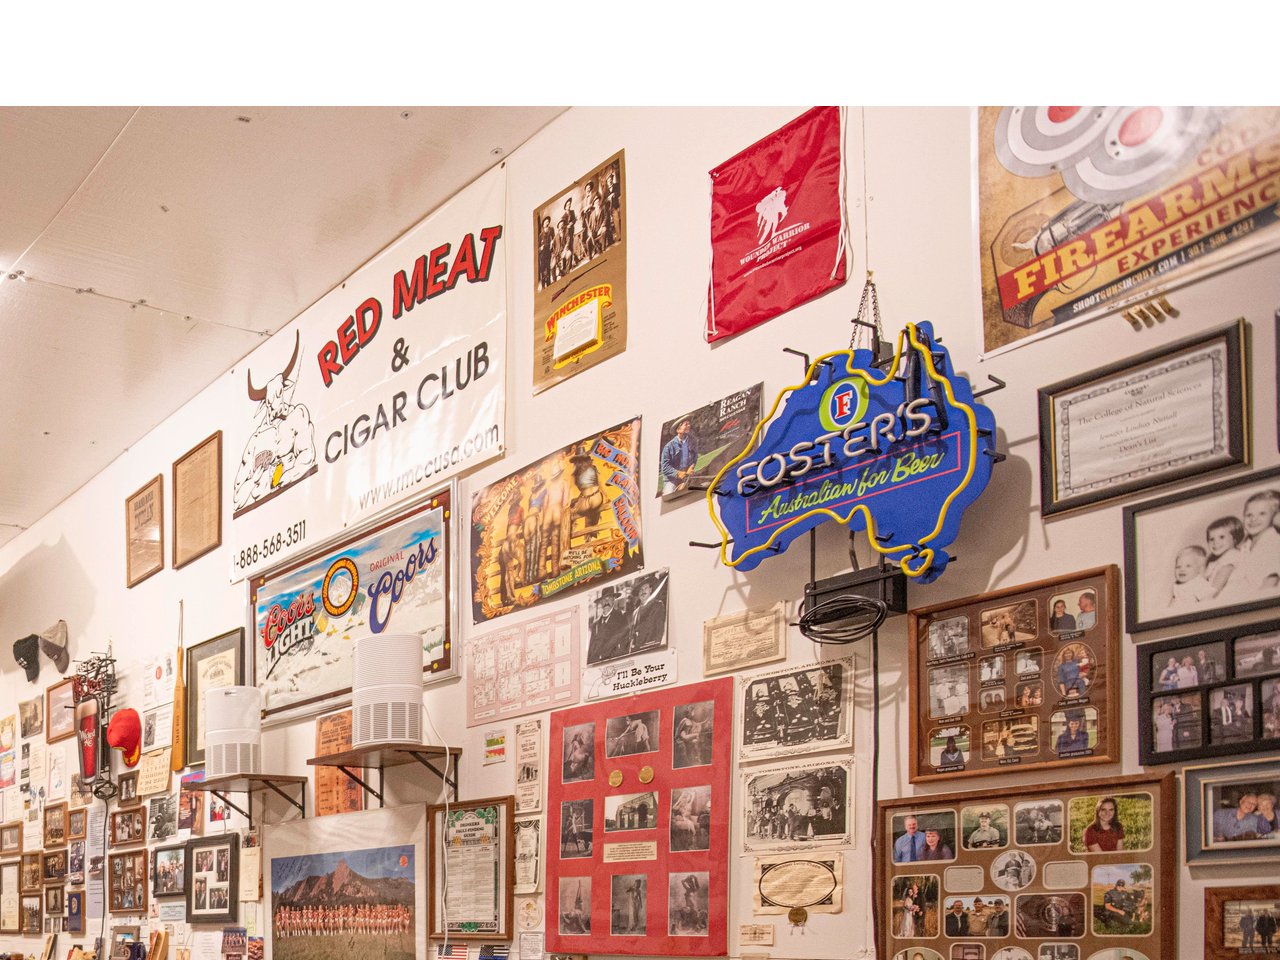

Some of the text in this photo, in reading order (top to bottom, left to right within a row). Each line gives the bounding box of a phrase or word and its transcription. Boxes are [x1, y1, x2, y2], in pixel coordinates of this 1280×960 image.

[772, 222, 810, 245] WARRIOR
[1117, 174, 1280, 273] EXPERIENC
[756, 240, 788, 263] PROJECT
[317, 225, 503, 388] RED MEAT
[546, 285, 611, 333] WINCHESTER
[391, 336, 410, 373] &
[324, 340, 490, 465] CIGAR CLUB
[720, 399, 747, 418] RANCH
[721, 389, 751, 408] REAGAN
[834, 389, 853, 420] F
[1094, 407, 1123, 422] College
[1134, 392, 1166, 408] Natural
[358, 422, 499, 511] www.rmccusa.com
[736, 397, 932, 495] FOSTER'S
[482, 476, 519, 523] WELCOME
[758, 451, 945, 525] Australian for Beer
[369, 551, 405, 572] ORIGINAL
[542, 561, 602, 595] TOMBSTONE ARIZONA
[368, 536, 438, 634] Coors
[260, 591, 317, 650] Coors
[617, 663, 666, 681] I'll Be Your
